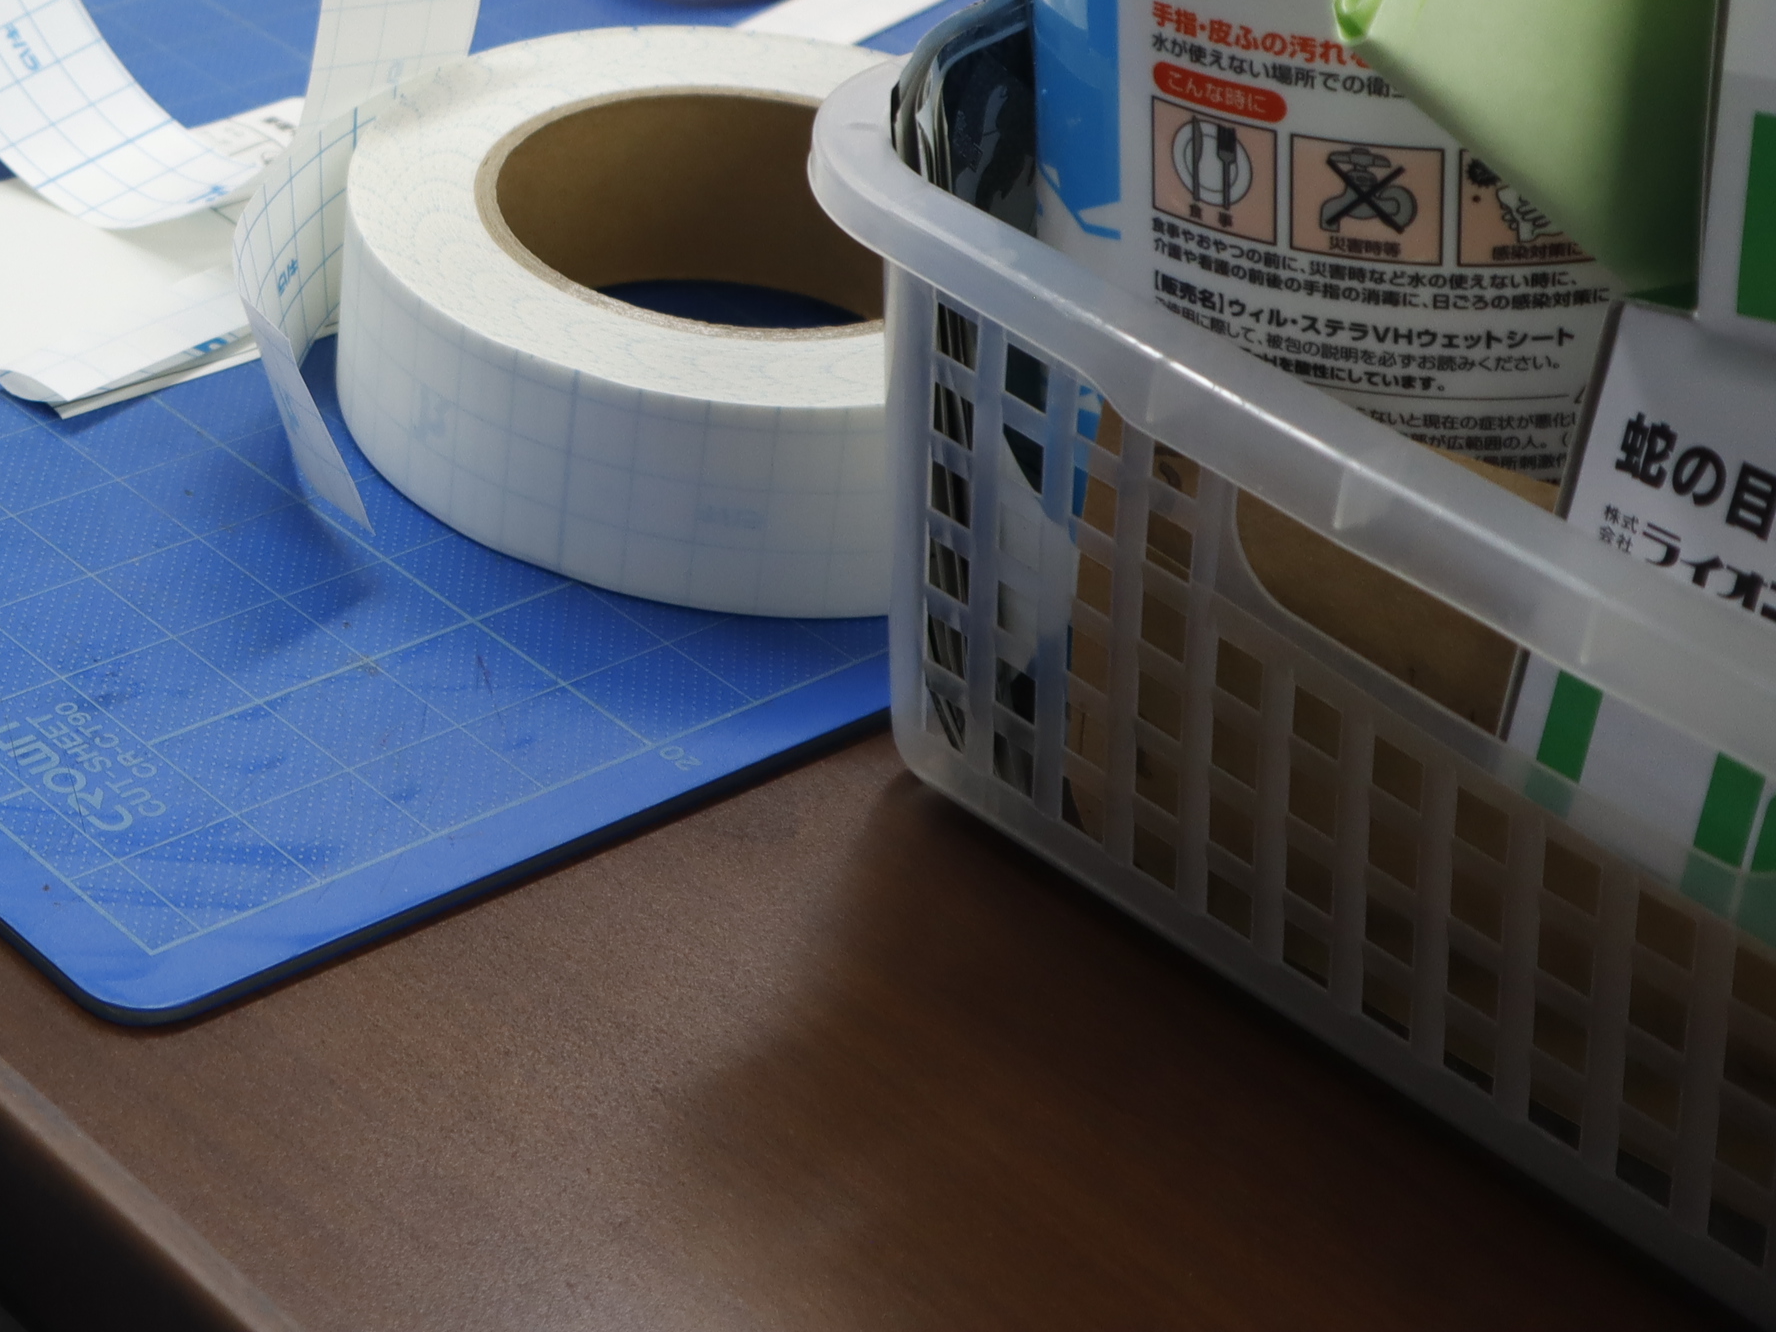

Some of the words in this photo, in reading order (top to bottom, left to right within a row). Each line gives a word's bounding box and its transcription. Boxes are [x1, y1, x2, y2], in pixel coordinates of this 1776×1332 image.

[1152, 0, 1373, 70] 手指・皮ふの汚れ
[1152, 32, 1407, 99] 水が使えない場所での衛
[1167, 71, 1268, 114] こんな時に
[1356, 406, 1576, 431] ないと現在の症状が悪化
[25, 713, 168, 818] CUT-SHEET
[54, 701, 159, 780] CR-CT90
[659, 745, 703, 771] 20
